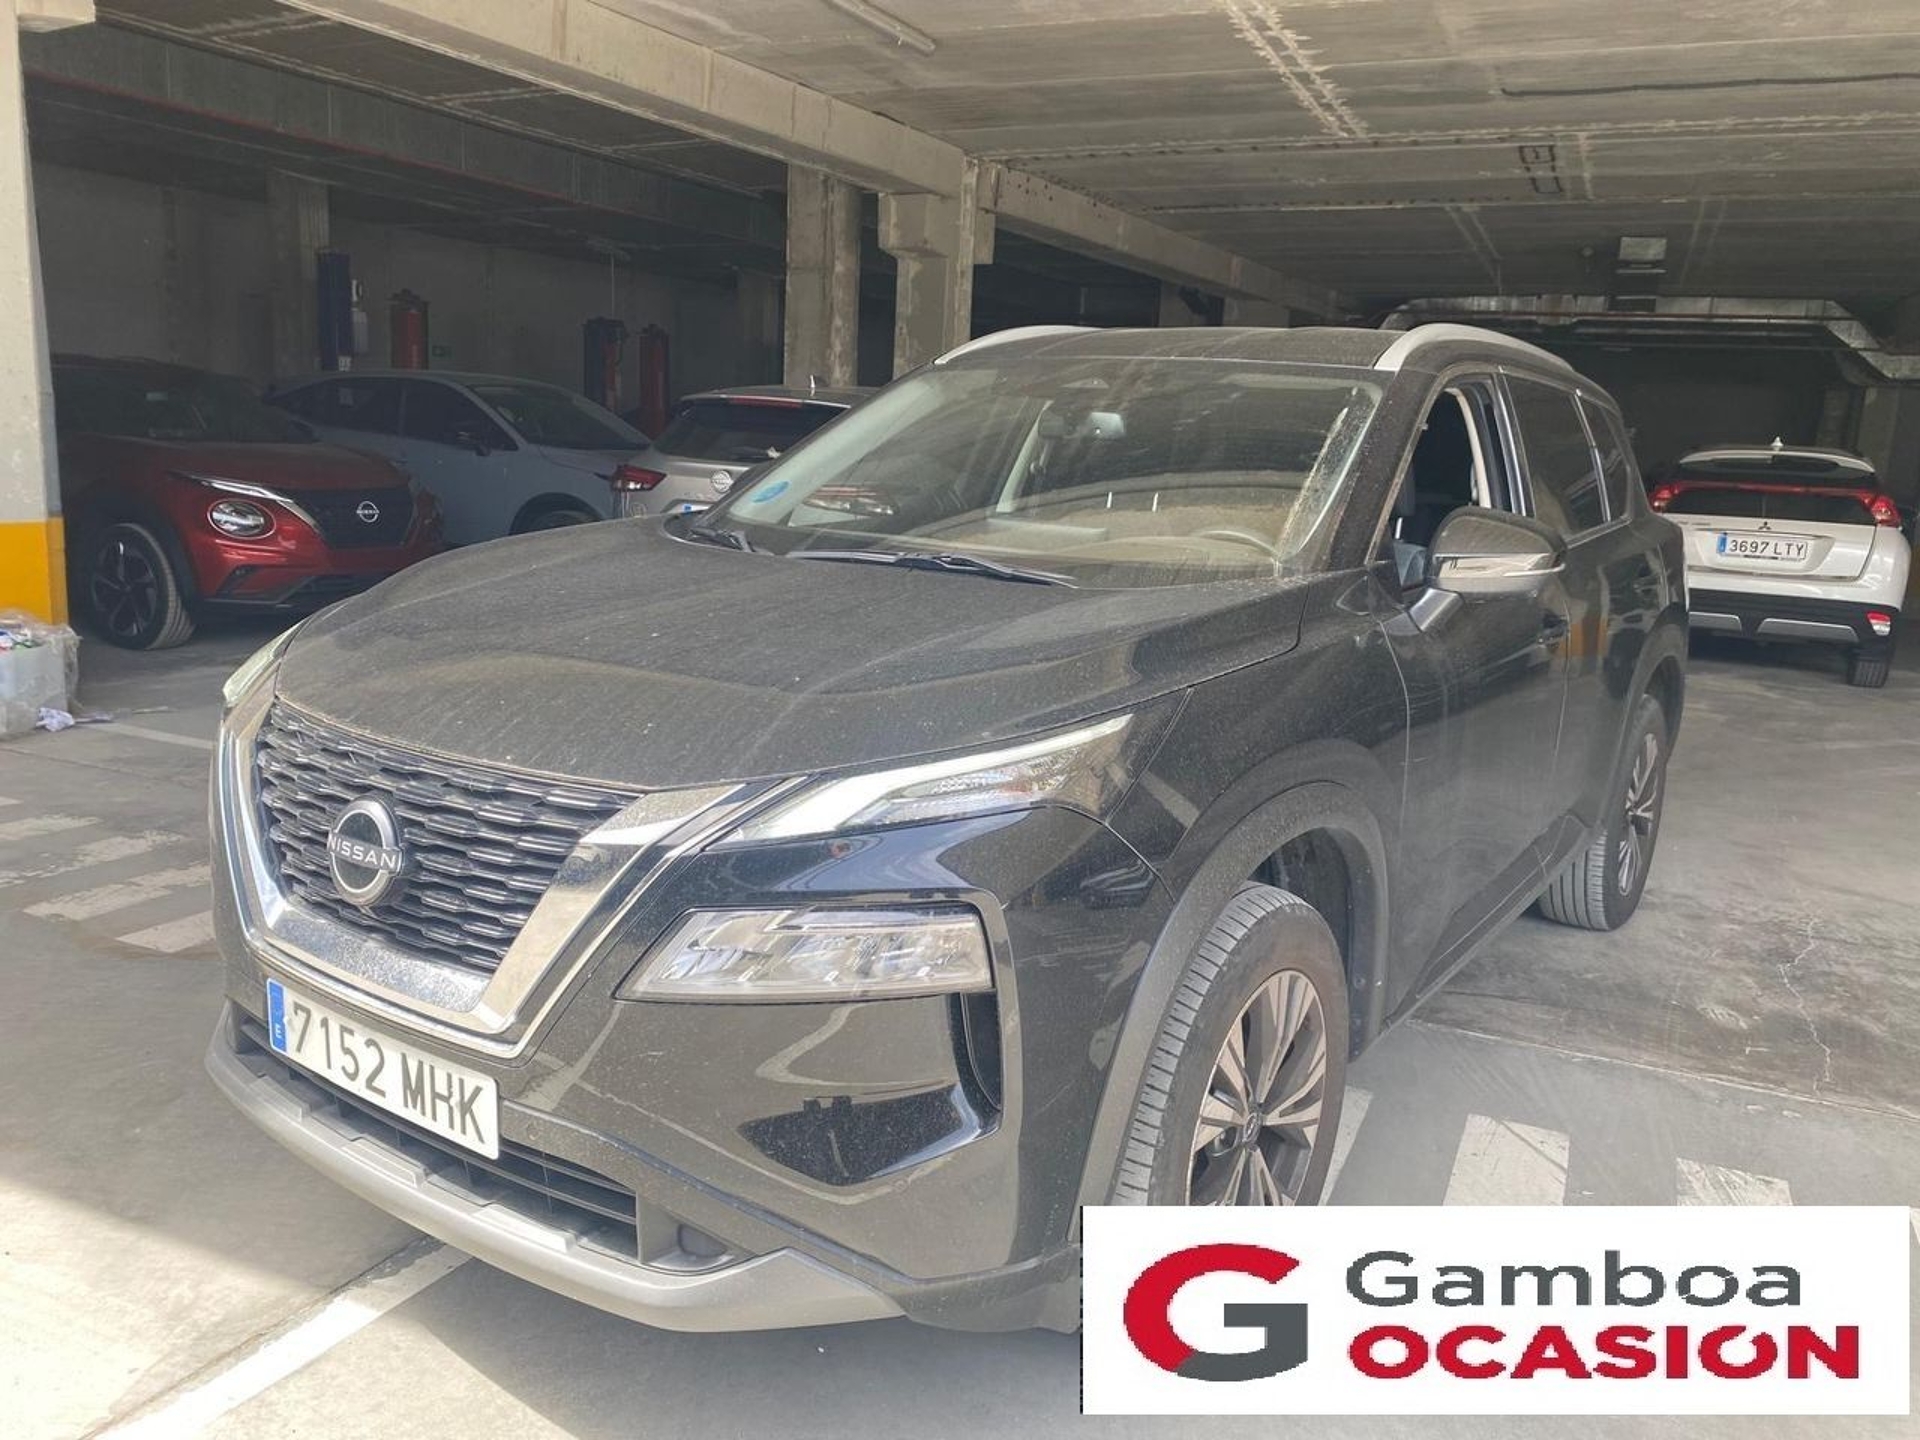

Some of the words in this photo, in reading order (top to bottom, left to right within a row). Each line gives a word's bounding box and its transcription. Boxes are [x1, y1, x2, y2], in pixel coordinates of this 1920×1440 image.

[1729, 539, 1769, 554] 3697
[1773, 542, 1804, 557] LTY
[327, 832, 396, 869] NISSAN
[293, 1001, 386, 1099] 7152
[401, 1052, 485, 1145] MHK
